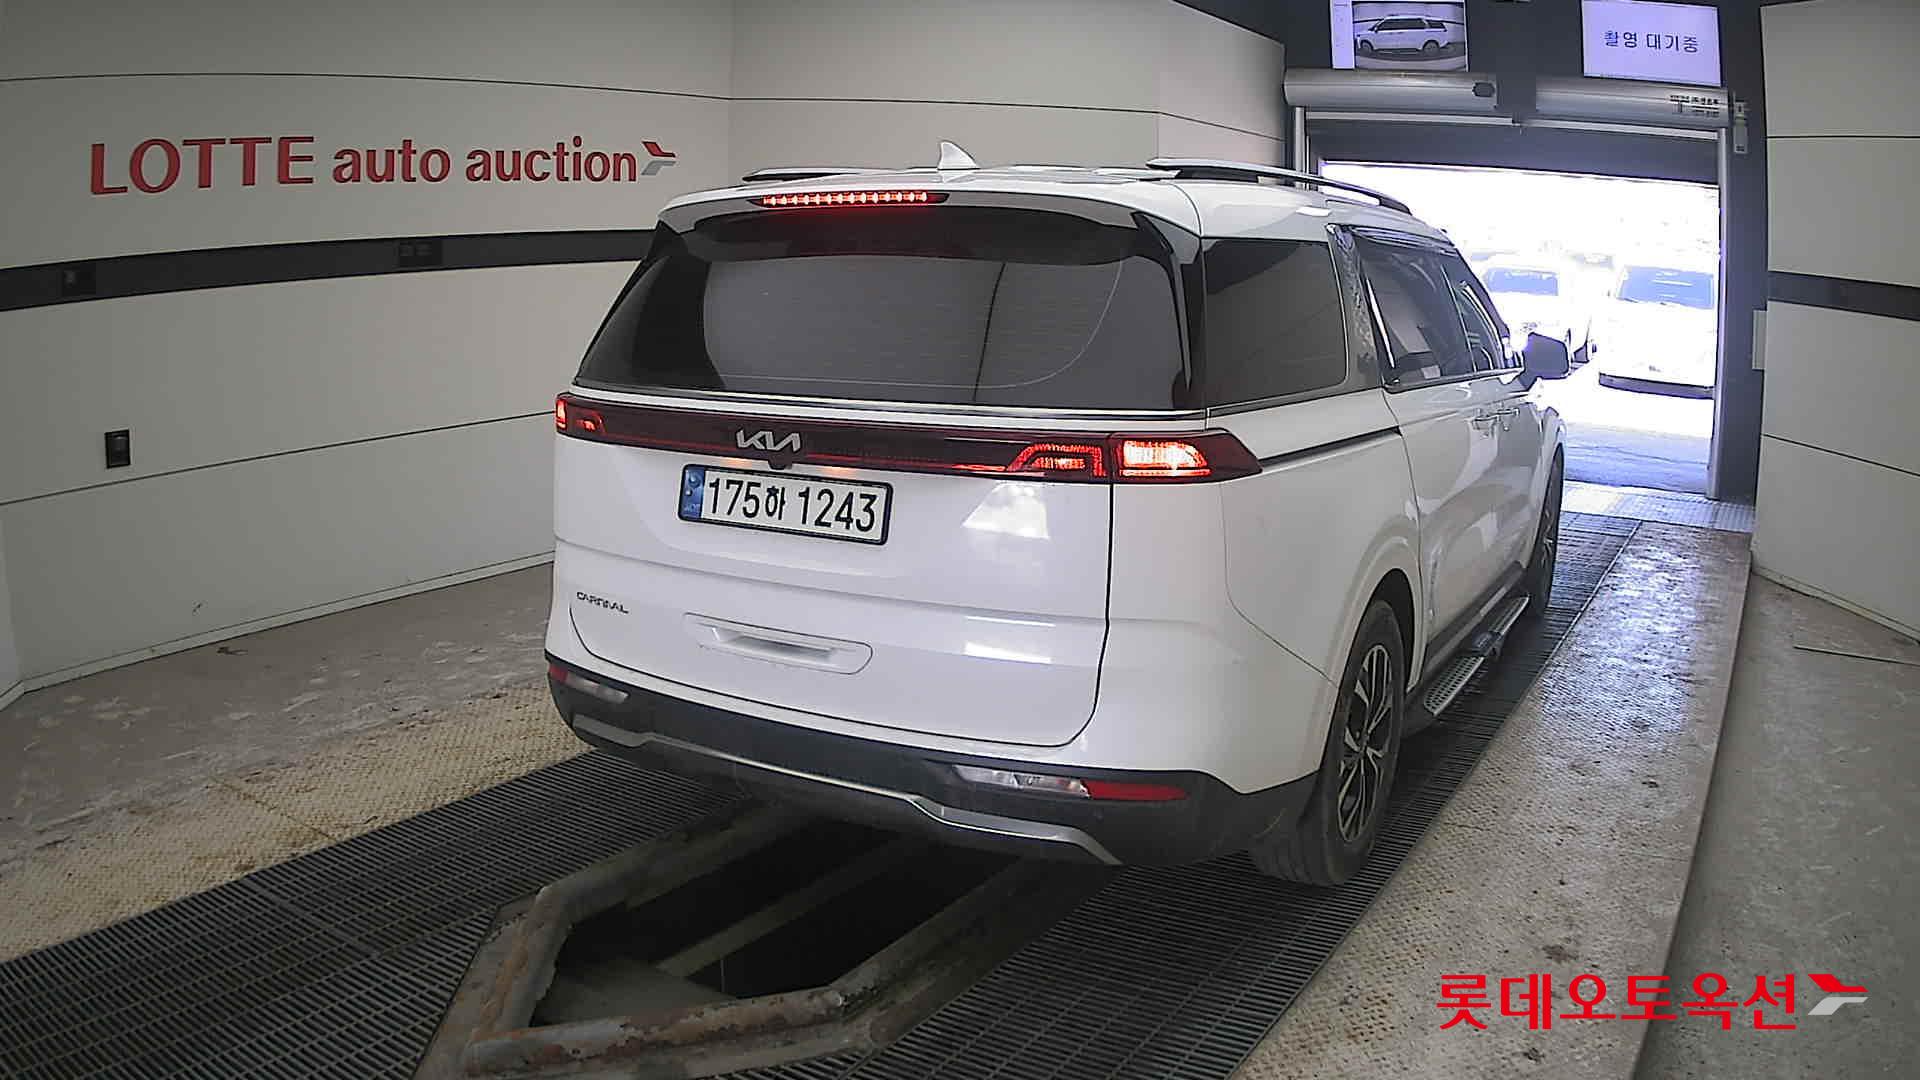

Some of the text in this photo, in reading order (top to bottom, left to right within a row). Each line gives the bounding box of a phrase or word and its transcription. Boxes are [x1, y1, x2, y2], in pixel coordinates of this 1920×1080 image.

[1604, 30, 1698, 53] 촬영 대기중
[90, 135, 638, 195] LOTTE auto auction
[735, 429, 802, 453] KIA
[709, 478, 878, 533] 175하 1243
